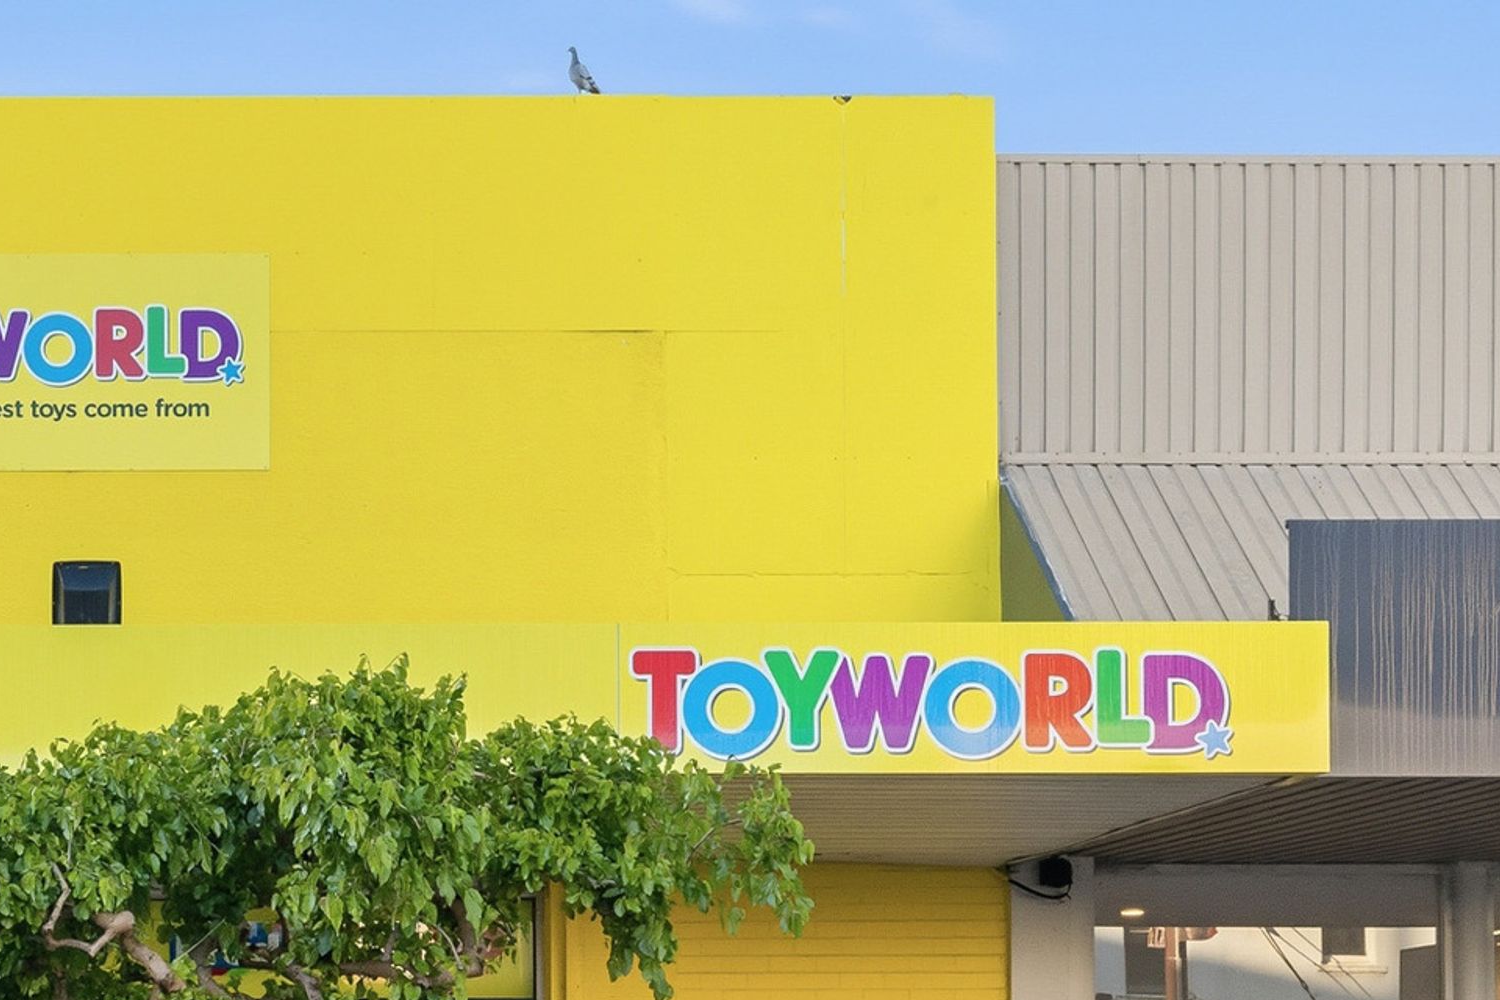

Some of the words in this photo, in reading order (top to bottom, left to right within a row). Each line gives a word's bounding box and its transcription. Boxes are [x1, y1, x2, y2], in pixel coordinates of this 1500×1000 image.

[31, 401, 77, 422] toys
[84, 402, 148, 418] come
[155, 398, 210, 418] from
[629, 648, 1234, 760] TOYWORLD
